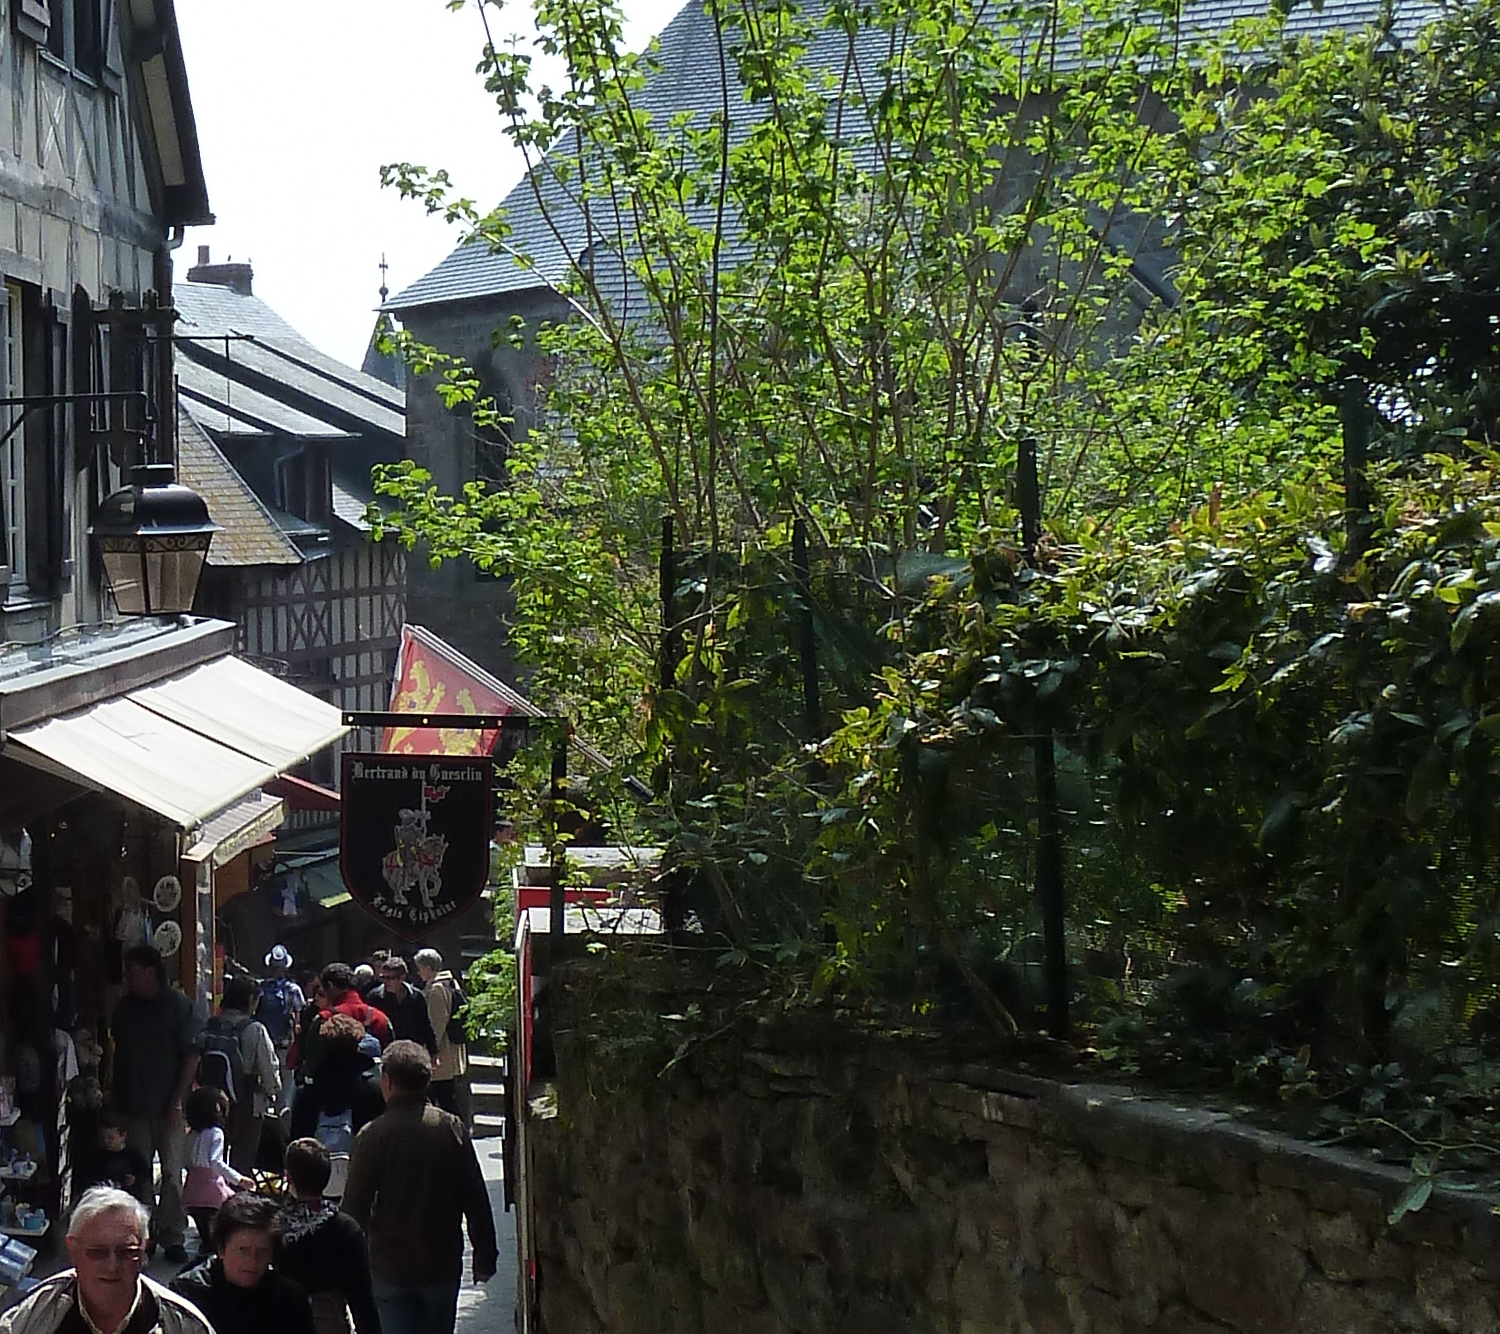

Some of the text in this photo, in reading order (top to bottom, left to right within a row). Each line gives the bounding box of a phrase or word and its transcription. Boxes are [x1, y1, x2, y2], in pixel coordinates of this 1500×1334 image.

[350, 760, 483, 783] Bertrand du Guesclin
